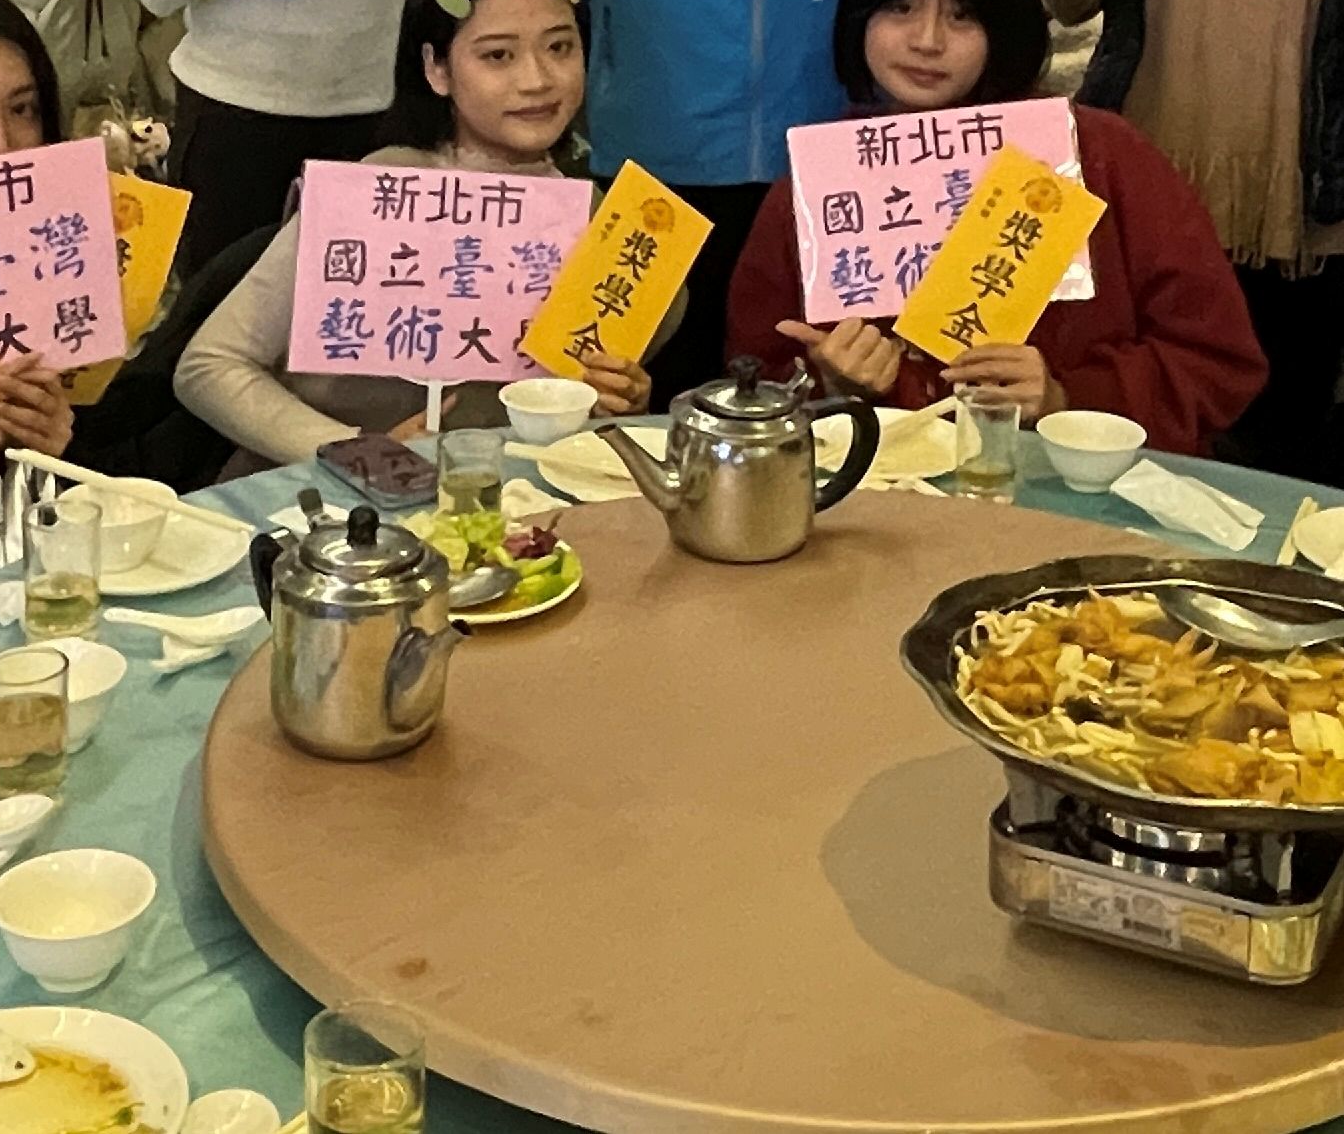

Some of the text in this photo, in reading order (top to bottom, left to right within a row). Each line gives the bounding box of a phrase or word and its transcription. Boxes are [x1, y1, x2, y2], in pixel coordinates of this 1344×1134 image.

[856, 112, 1004, 169] 新北市
[372, 173, 527, 229] 新北市
[822, 168, 973, 236] 國立臺
[324, 234, 562, 302] 國立臺灣
[562, 227, 659, 366] 獎學金
[939, 210, 1044, 348] 獎學金
